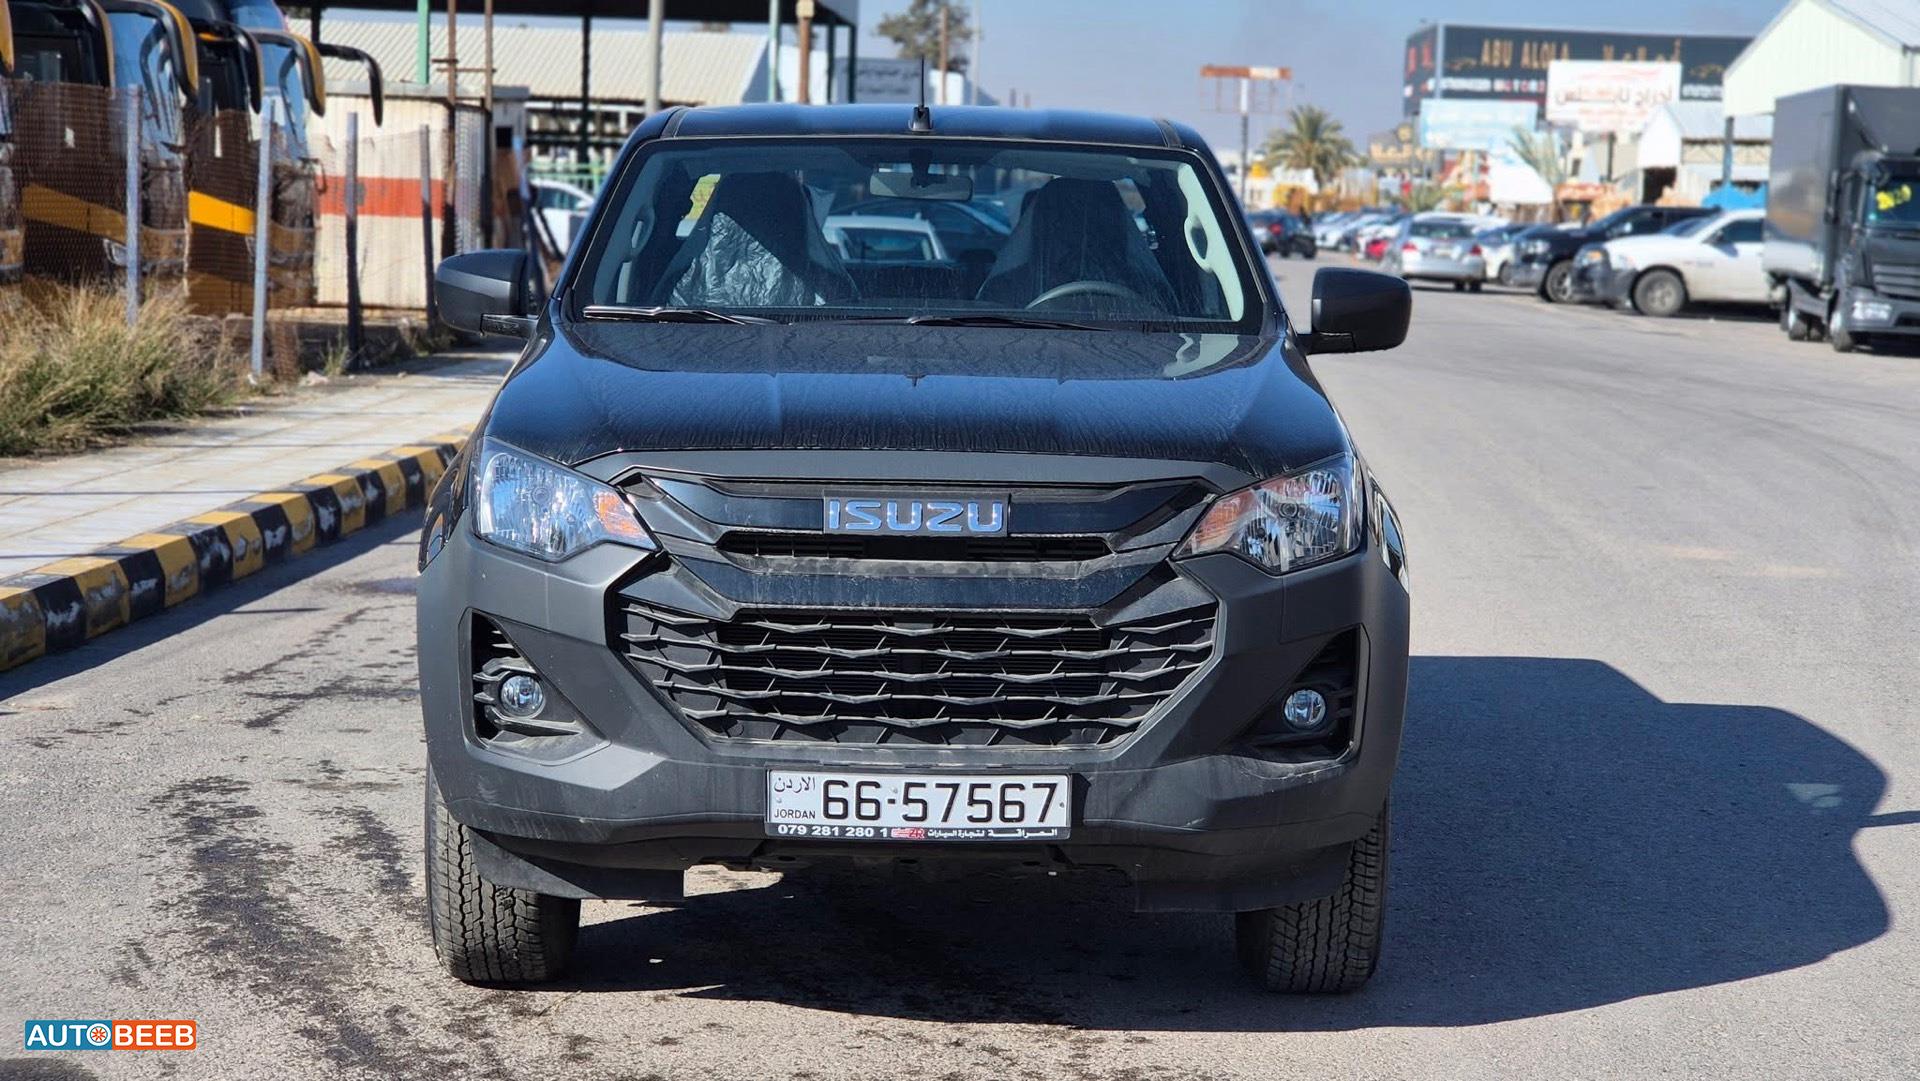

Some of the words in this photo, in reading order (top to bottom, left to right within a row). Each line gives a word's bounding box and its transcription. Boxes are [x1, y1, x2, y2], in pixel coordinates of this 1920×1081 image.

[1481, 39, 1513, 68] ABU
[829, 499, 1003, 532] ISUZU
[774, 809, 816, 819] JORDAN
[778, 824, 807, 835] 079
[811, 825, 839, 836] 281
[845, 827, 874, 837] 280
[880, 828, 887, 837] 1
[927, 828, 957, 839] السيارات
